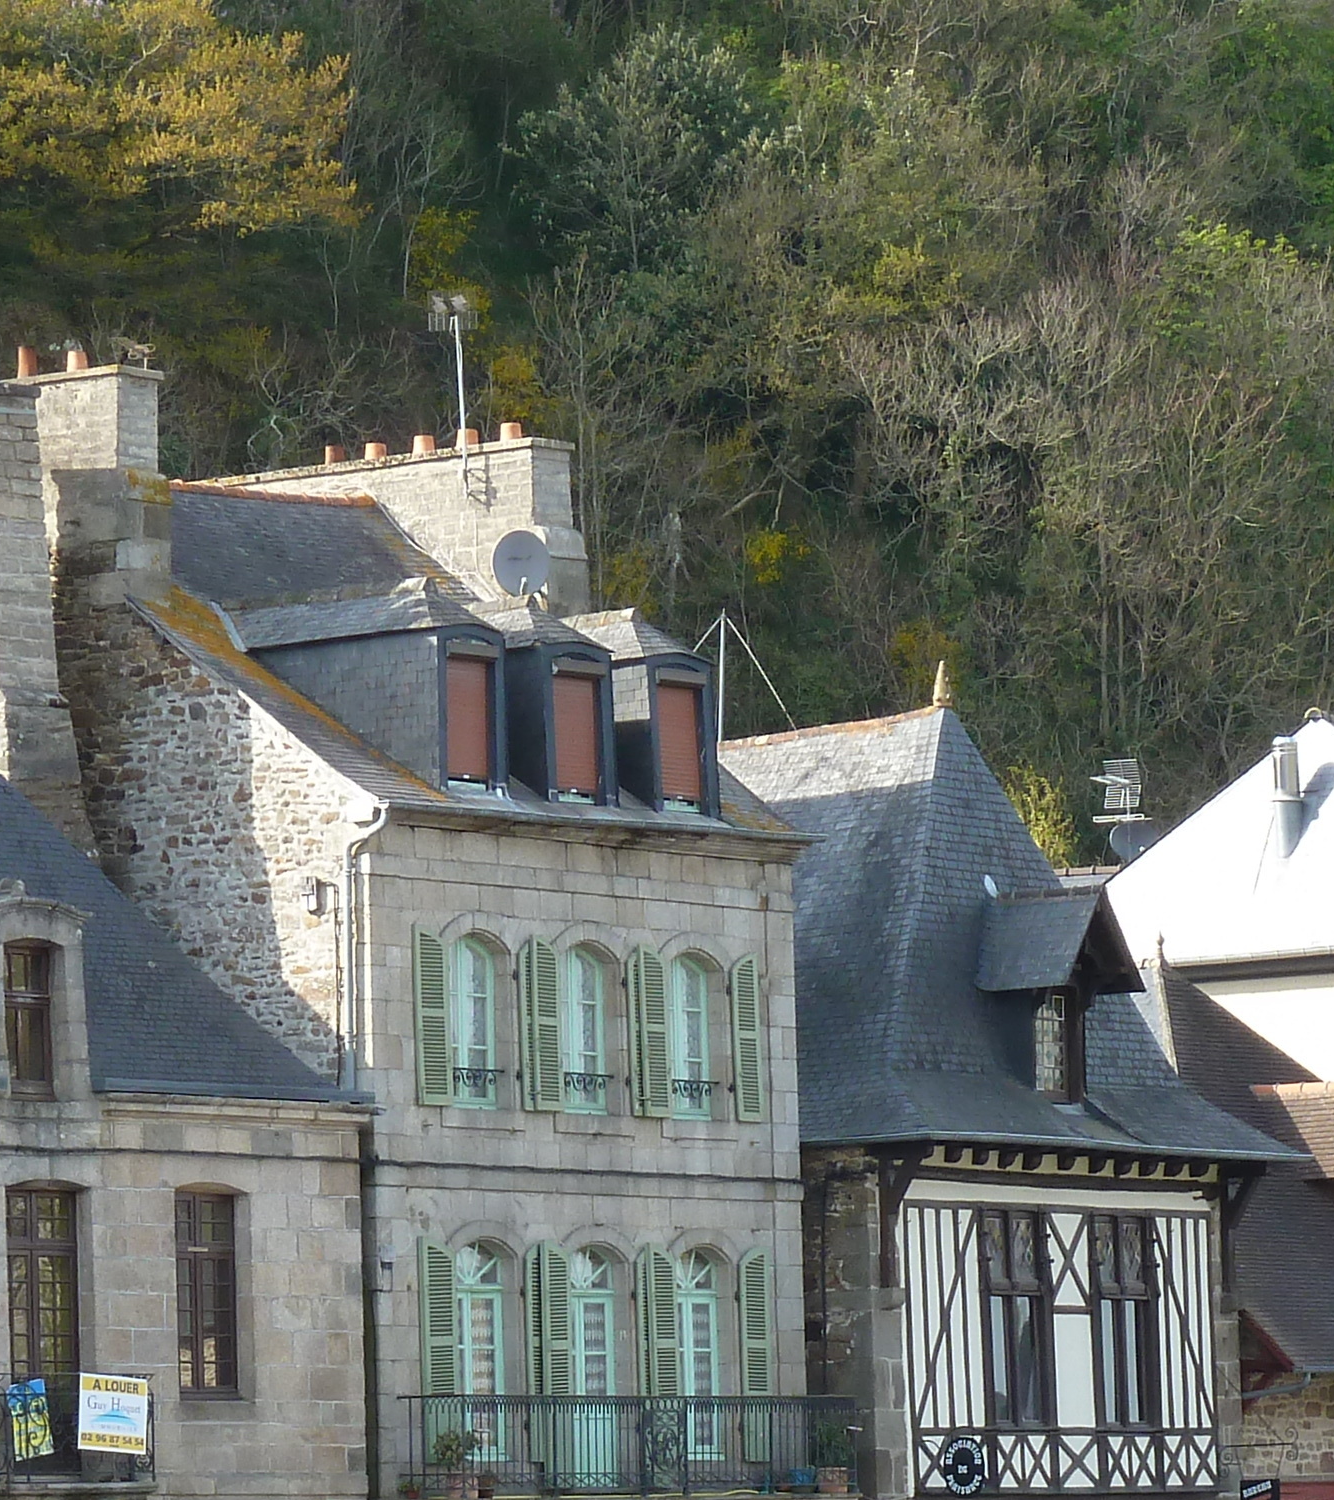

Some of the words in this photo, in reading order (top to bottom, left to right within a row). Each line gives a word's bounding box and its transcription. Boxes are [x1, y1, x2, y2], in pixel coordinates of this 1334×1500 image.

[92, 1379, 101, 1391] A
[105, 1380, 139, 1395] LOUER
[87, 1395, 107, 1411] Guy
[81, 1433, 93, 1442] 02
[96, 1434, 107, 1443] 96
